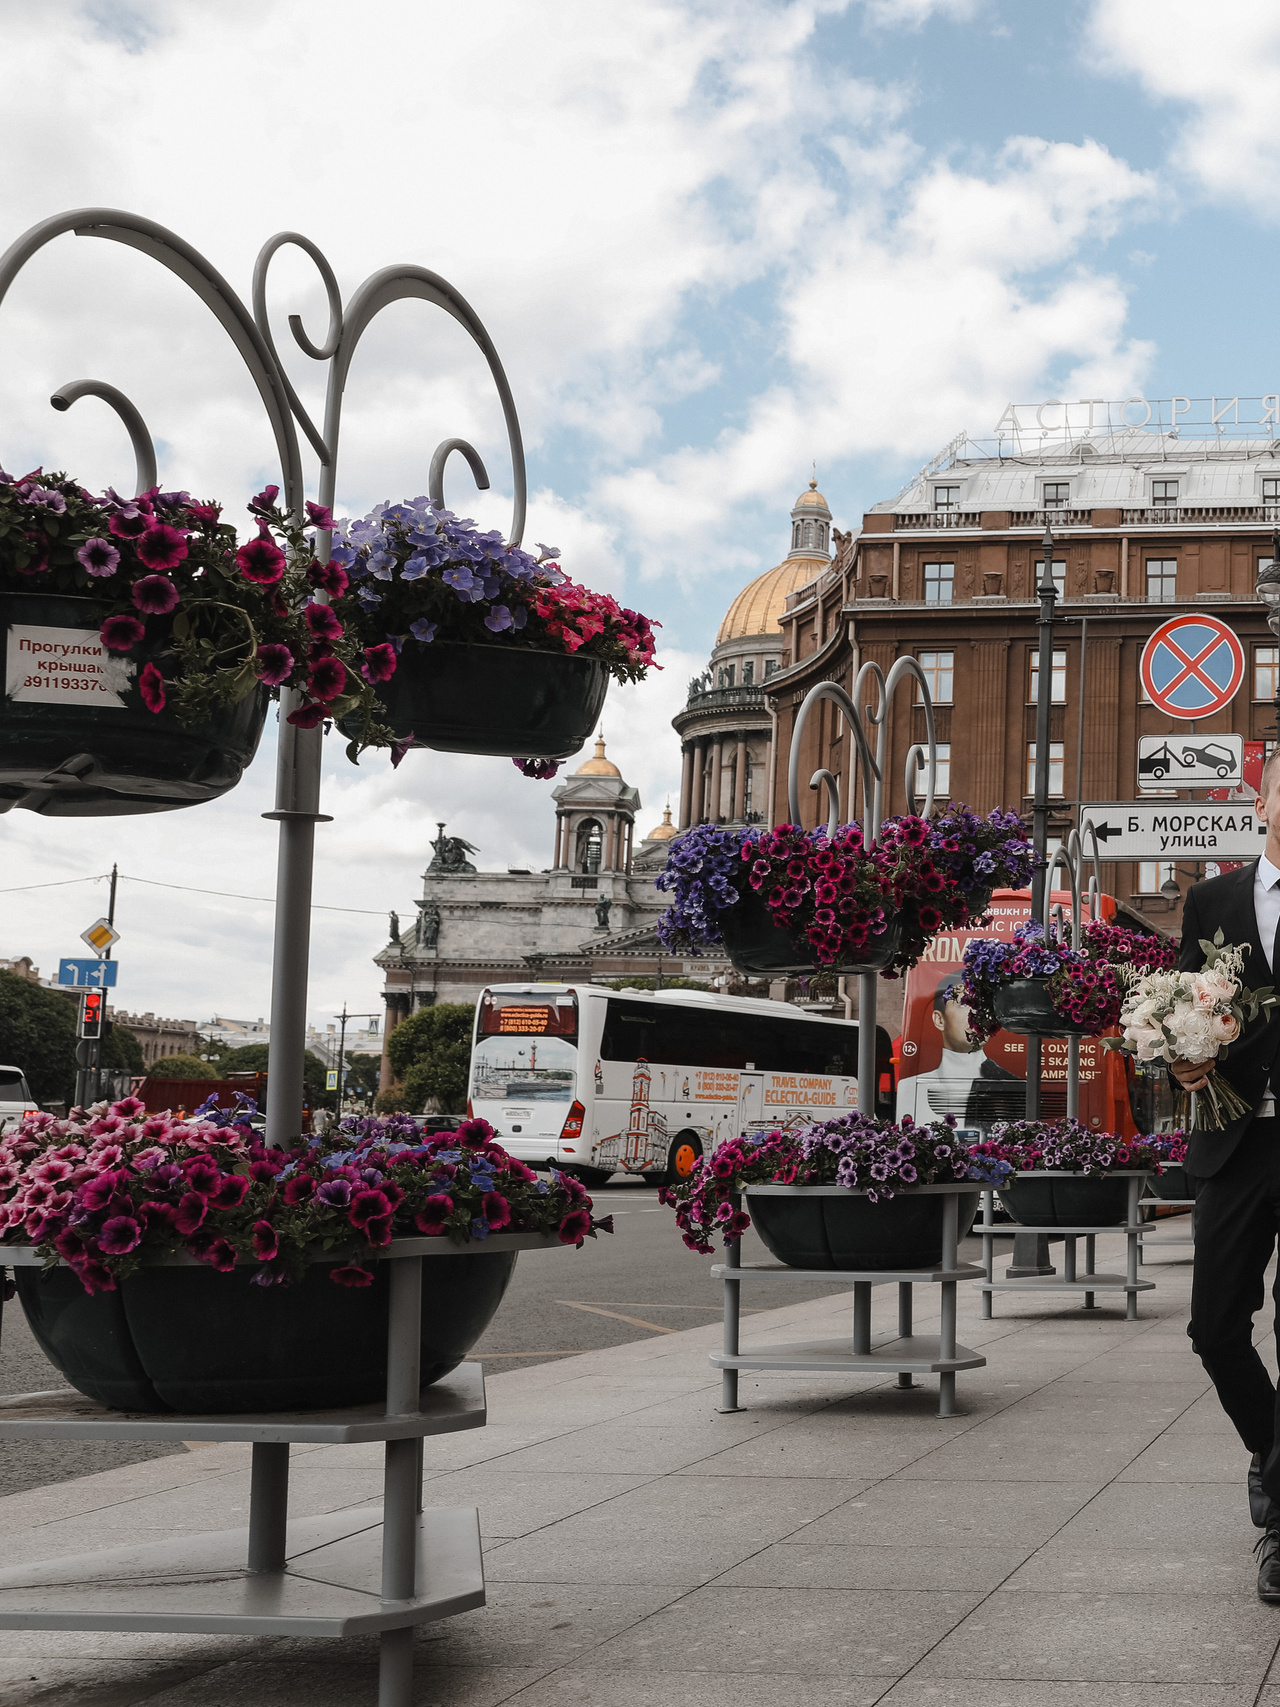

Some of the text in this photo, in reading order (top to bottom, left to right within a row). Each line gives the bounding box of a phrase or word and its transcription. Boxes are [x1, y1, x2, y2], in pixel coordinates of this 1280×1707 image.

[994, 394, 1280, 432] АСТОРИЯ
[19, 638, 102, 657] Прогулки
[1128, 815, 1253, 833] Б. МОРСКАЯ
[1160, 835, 1217, 851] улица
[982, 908, 1019, 916] ERBUKH
[84, 1009, 100, 1022] 21
[904, 1045, 916, 1053] 12+
[1004, 1043, 1024, 1053] SEE
[1048, 1044, 1096, 1054] OLYPIC
[1048, 1057, 1095, 1067] SKANG
[1025, 1070, 1095, 1080] AMPINS!
[771, 1075, 833, 1090] TRAVEL COMPANY
[765, 1089, 836, 1105] ECLECTICA-GUIDE
